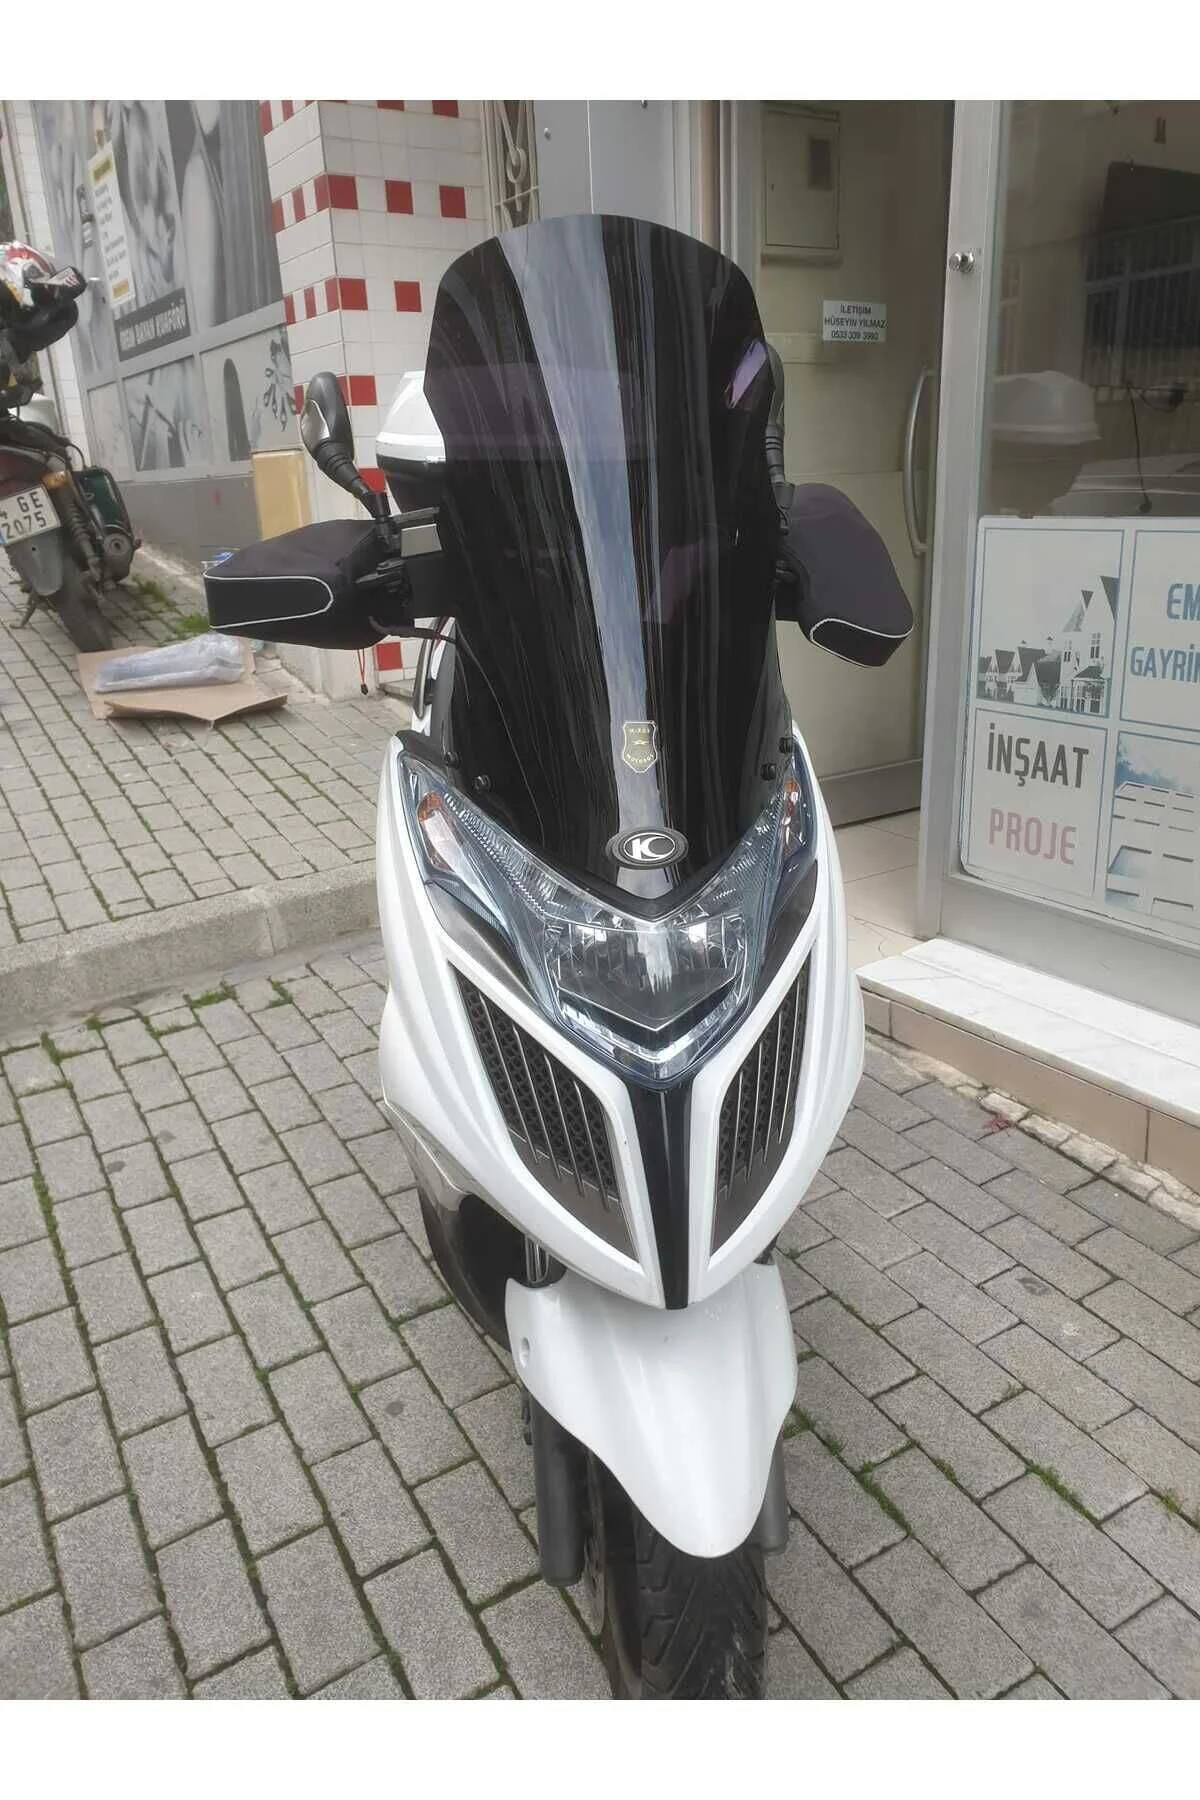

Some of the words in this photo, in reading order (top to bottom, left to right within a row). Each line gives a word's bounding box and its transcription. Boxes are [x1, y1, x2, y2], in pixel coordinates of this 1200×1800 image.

[17, 491, 43, 513] GE
[1, 511, 47, 539] 2075
[1129, 643, 1200, 683] GAYRİ
[987, 722, 1089, 788] İNŞAAT
[988, 808, 1077, 865] PROJE
